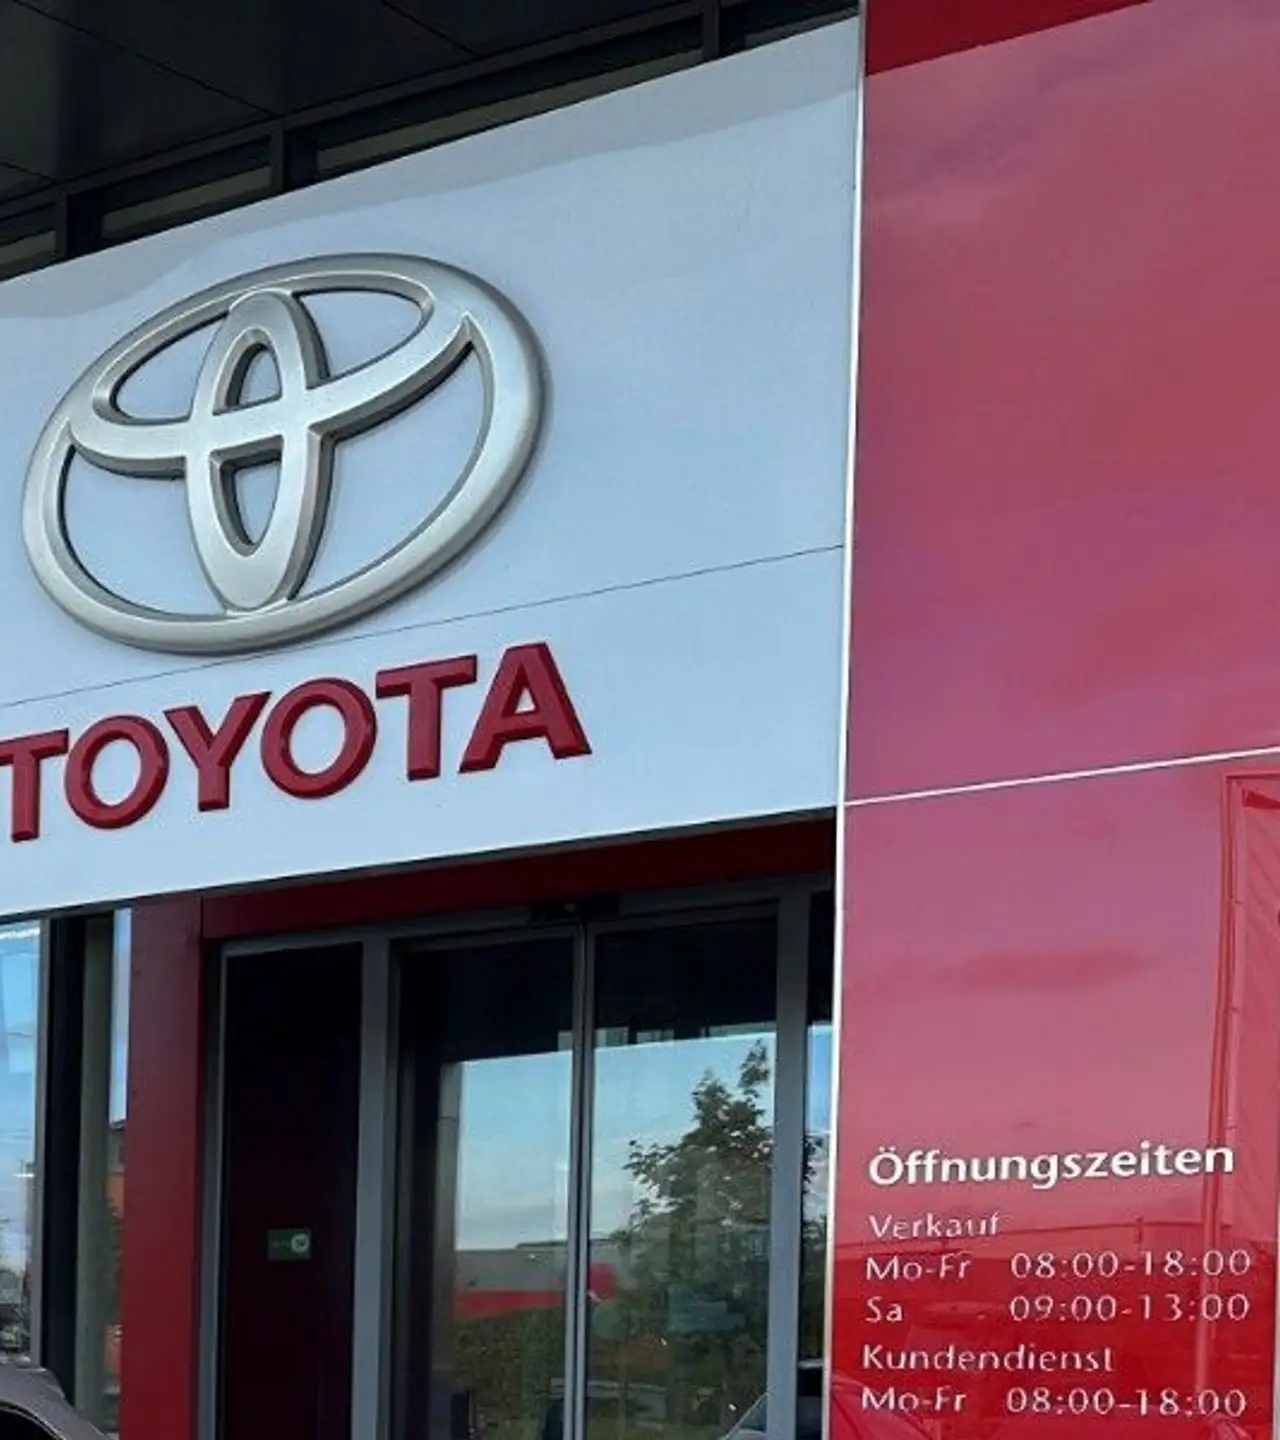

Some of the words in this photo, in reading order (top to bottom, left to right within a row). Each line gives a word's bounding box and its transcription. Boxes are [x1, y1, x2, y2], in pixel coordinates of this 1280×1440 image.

[868, 1140, 1234, 1190] Öffnungszeiten
[868, 1211, 1001, 1240] Verkauf
[865, 1253, 972, 1281] Mo-Fr
[1010, 1249, 1251, 1279] 08:00-18:00
[865, 1295, 905, 1324] Sa
[1009, 1293, 1250, 1322] 09:00-13:00
[862, 1343, 1116, 1373] Kundendienst
[861, 1385, 967, 1413] Mo-Fr
[1006, 1387, 1247, 1417] 08:00-18:00
